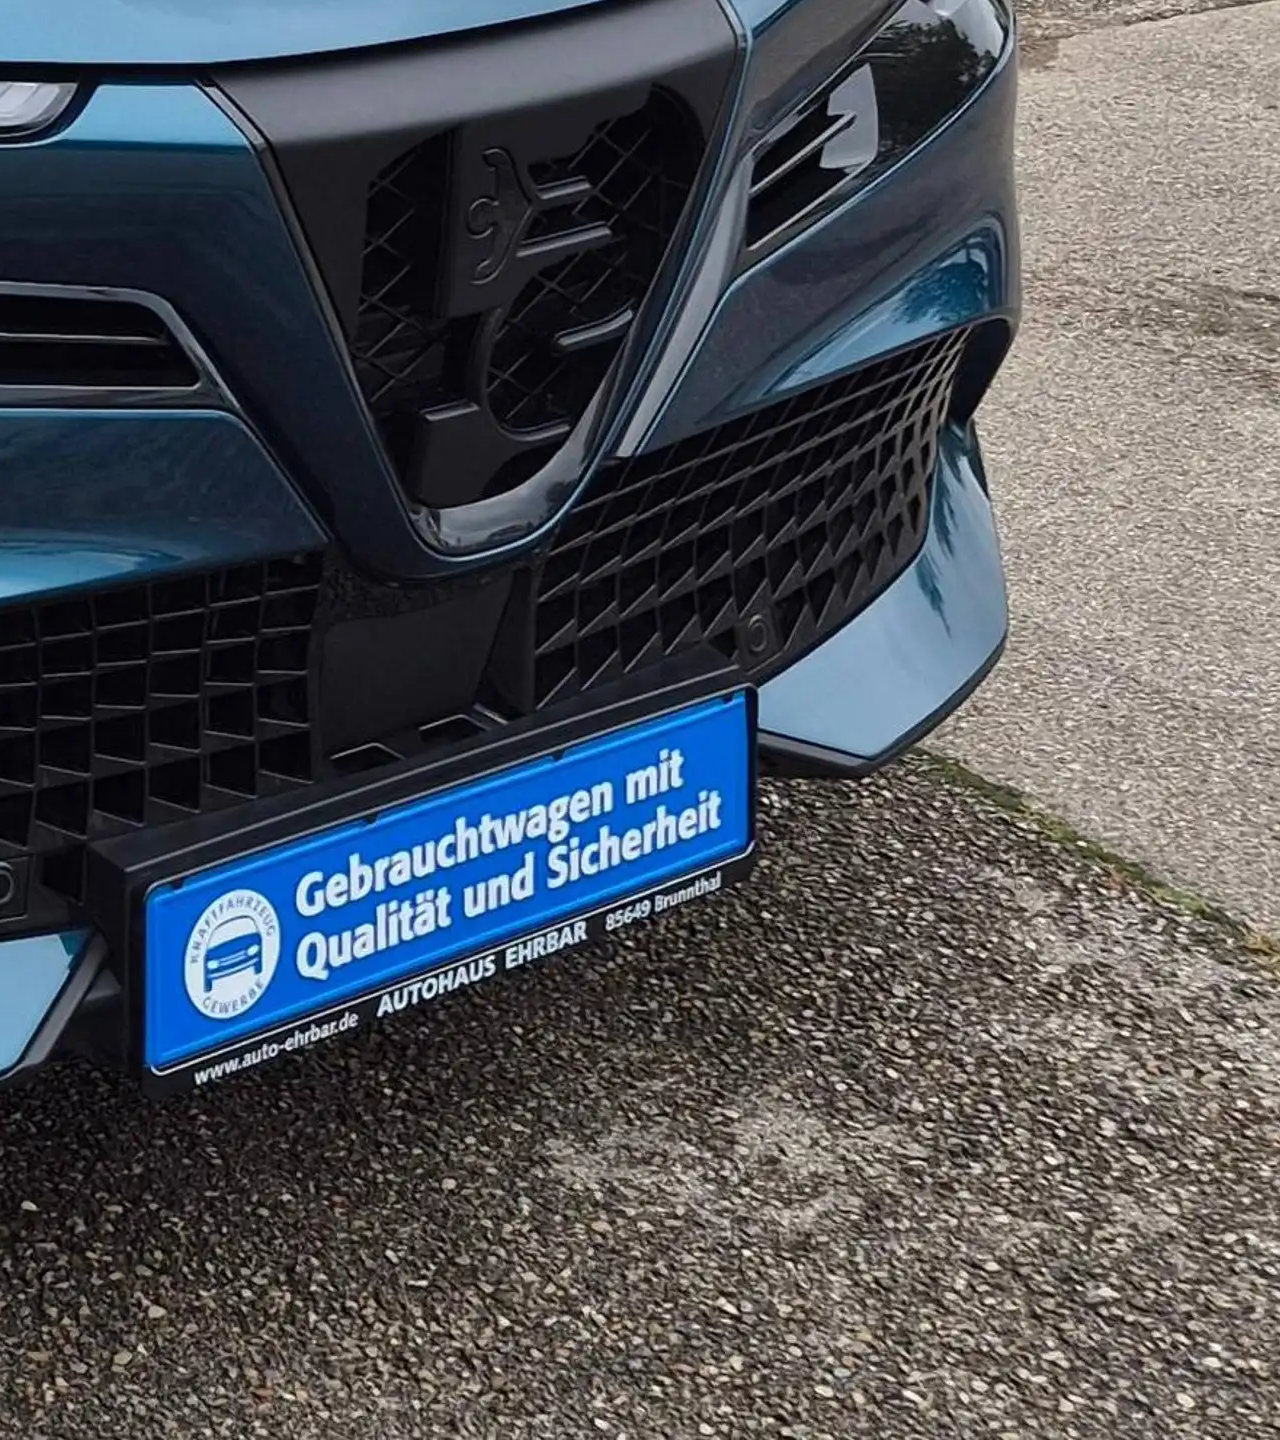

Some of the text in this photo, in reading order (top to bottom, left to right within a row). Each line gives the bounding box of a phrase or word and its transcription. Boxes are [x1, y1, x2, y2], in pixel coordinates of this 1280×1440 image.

[295, 748, 685, 917] Gebrauchtwagen mit
[295, 790, 722, 981] Qualität und Sicherheit
[194, 870, 722, 1086] www.auto-ehrbar.de AUTOHAUS EHRBAR 85649 Brunnthal
[202, 979, 263, 1015] GEWERBE
